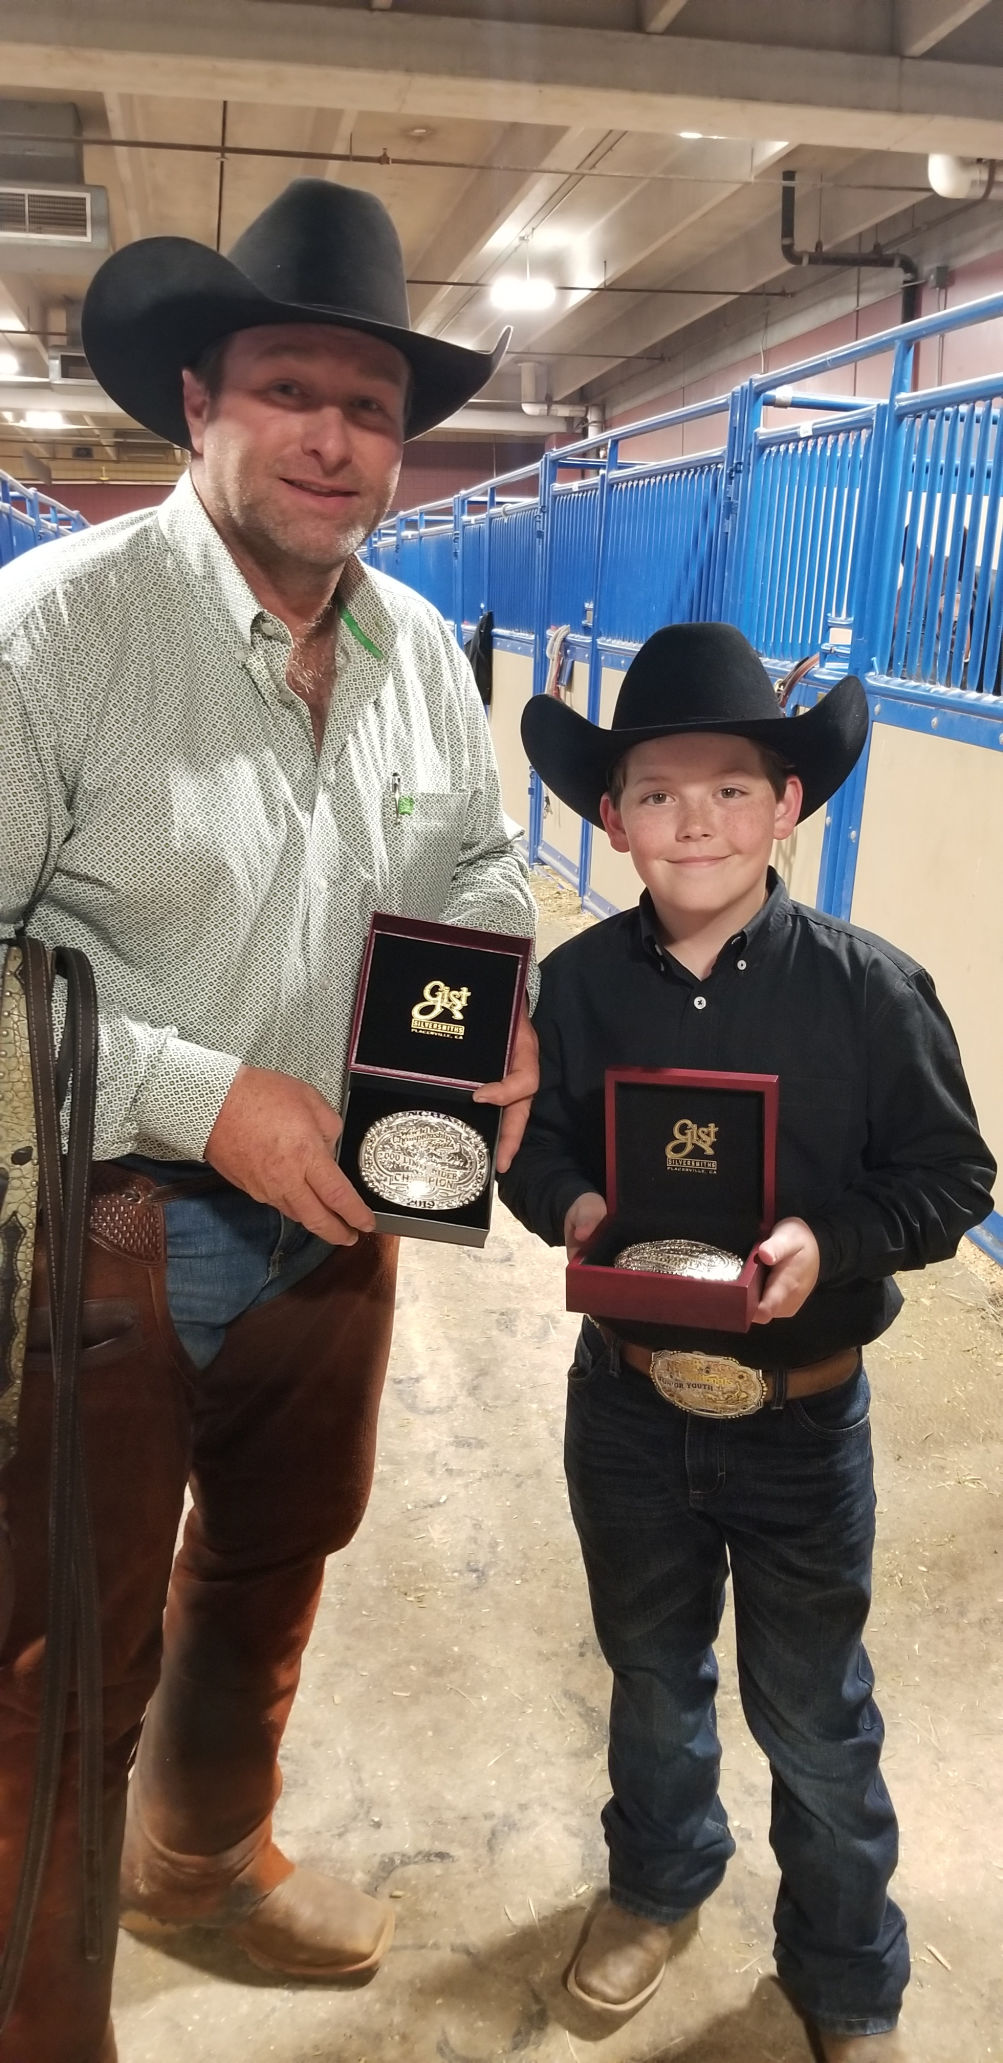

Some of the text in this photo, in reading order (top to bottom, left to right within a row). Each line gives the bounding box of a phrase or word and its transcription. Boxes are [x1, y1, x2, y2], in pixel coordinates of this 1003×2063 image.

[412, 981, 471, 1020] Gist
[412, 1020, 464, 1034] SILVERSMITHS
[665, 1119, 718, 1157] Gist
[667, 1159, 716, 1168] SILVERSMITHS
[394, 1173, 453, 1189] CHPION
[407, 1200, 435, 1209] 2019
[687, 1382, 714, 1392] YOUTH
